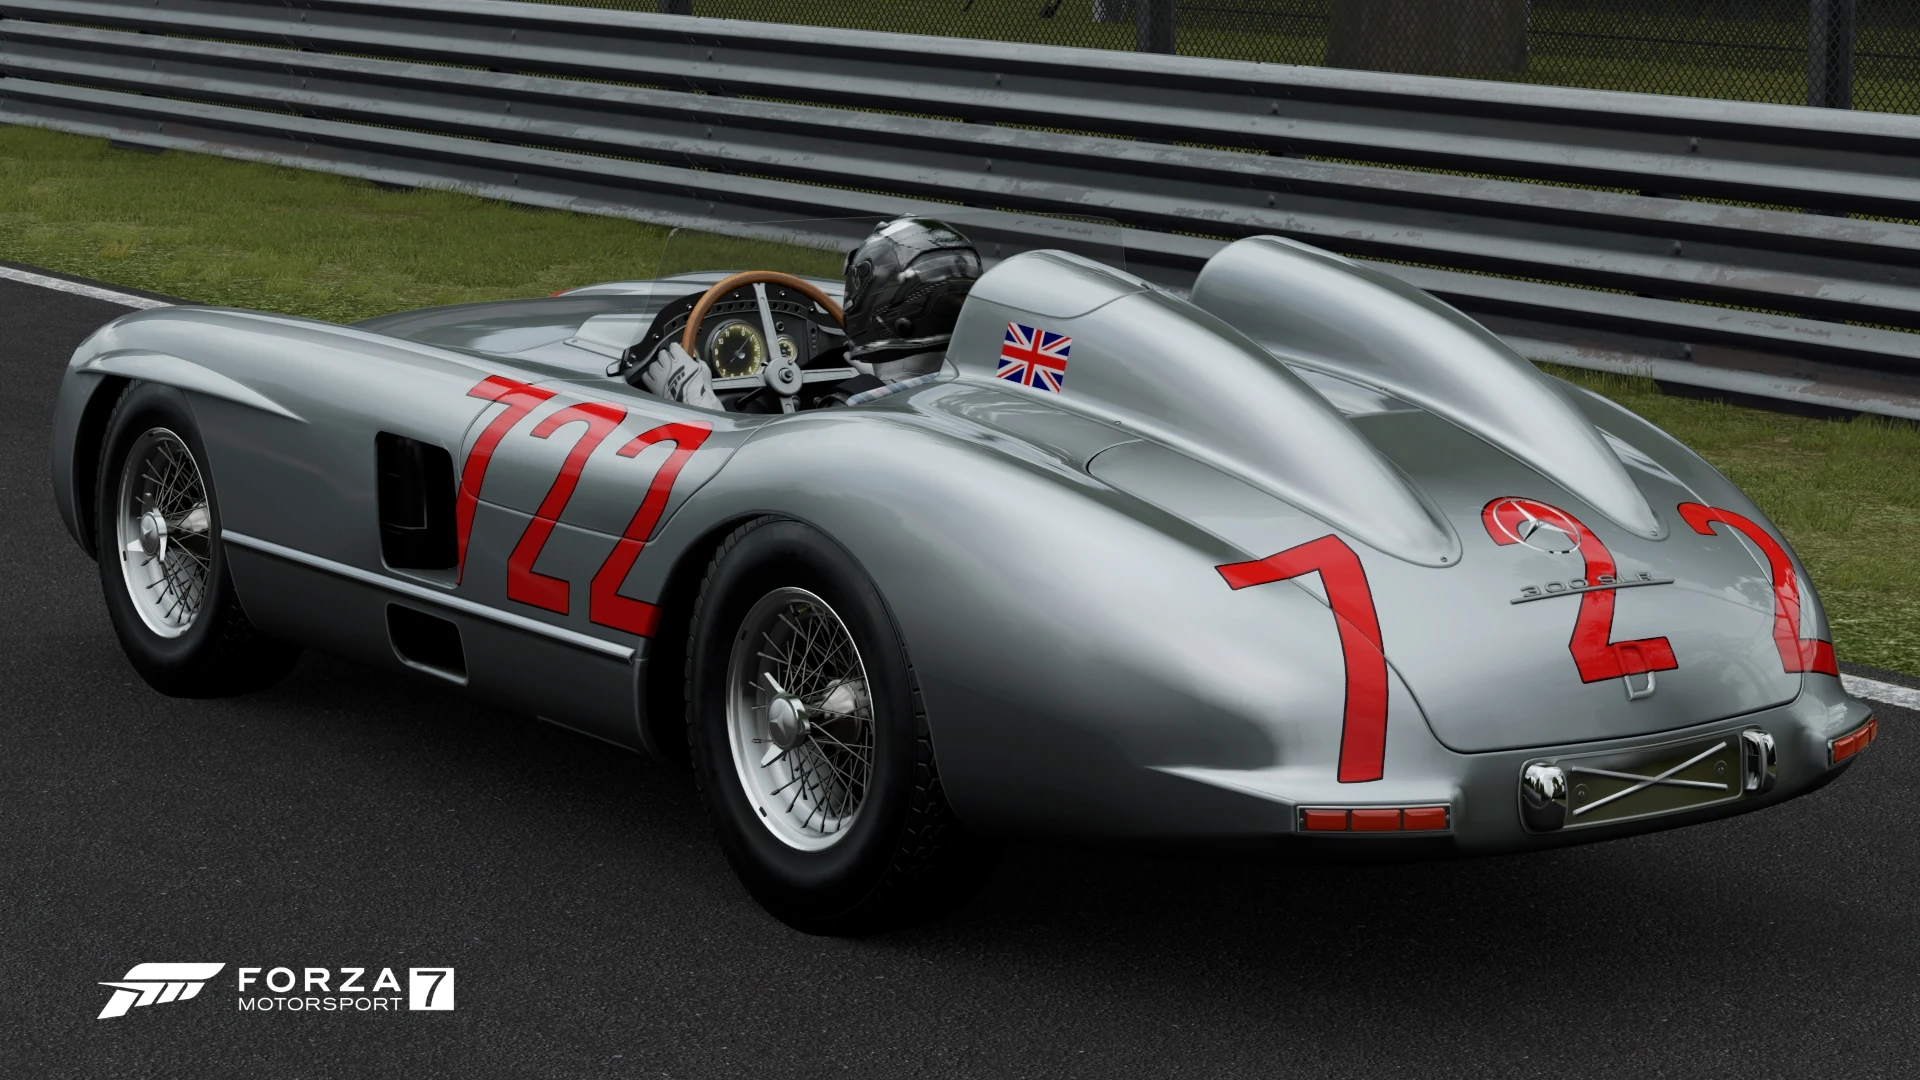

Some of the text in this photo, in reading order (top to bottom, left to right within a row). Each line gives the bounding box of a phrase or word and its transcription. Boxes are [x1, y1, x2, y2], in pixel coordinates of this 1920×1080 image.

[455, 374, 714, 639] 722
[1520, 571, 1656, 598] 300 SLR
